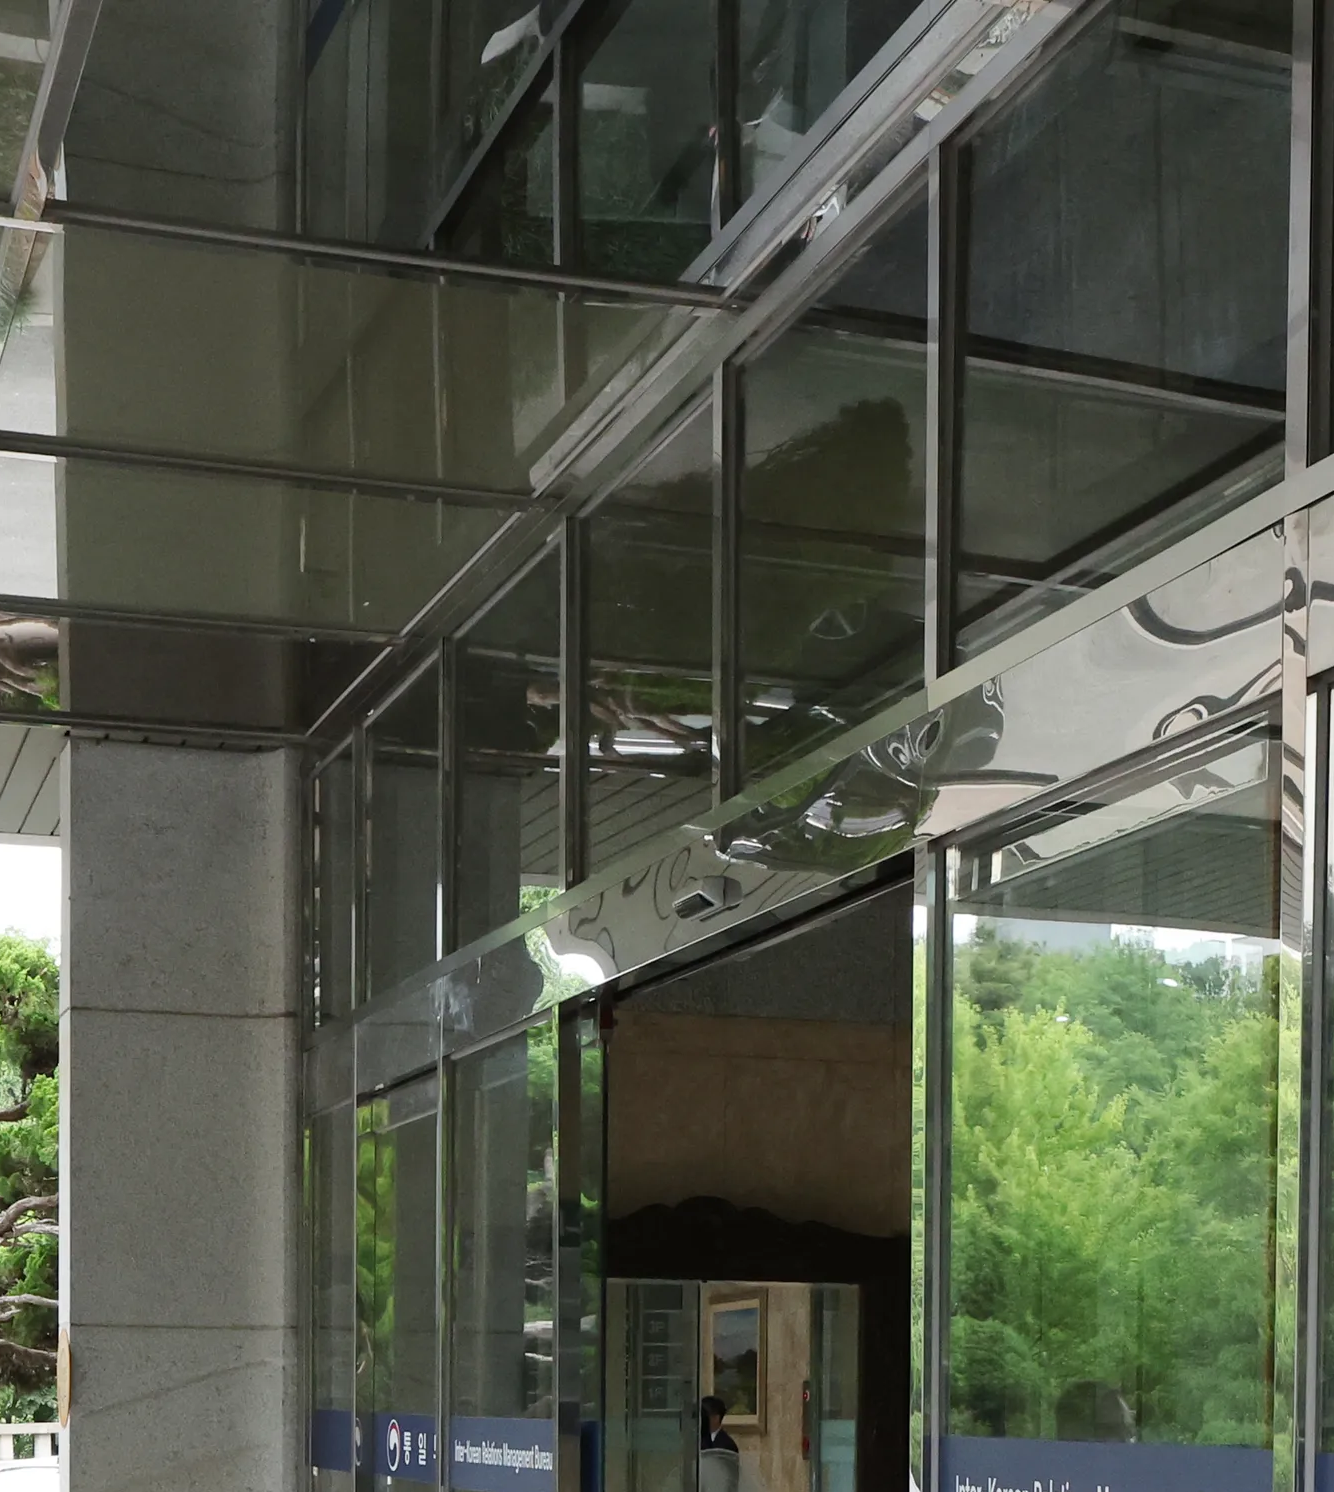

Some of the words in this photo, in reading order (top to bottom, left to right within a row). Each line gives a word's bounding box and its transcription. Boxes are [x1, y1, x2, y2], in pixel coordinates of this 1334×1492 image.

[403, 1431, 437, 1466] 통일
[454, 1439, 481, 1464] Inter-Korean
[482, 1440, 502, 1466] Relations
[503, 1442, 534, 1474] Management
[534, 1444, 553, 1471] Bureau
